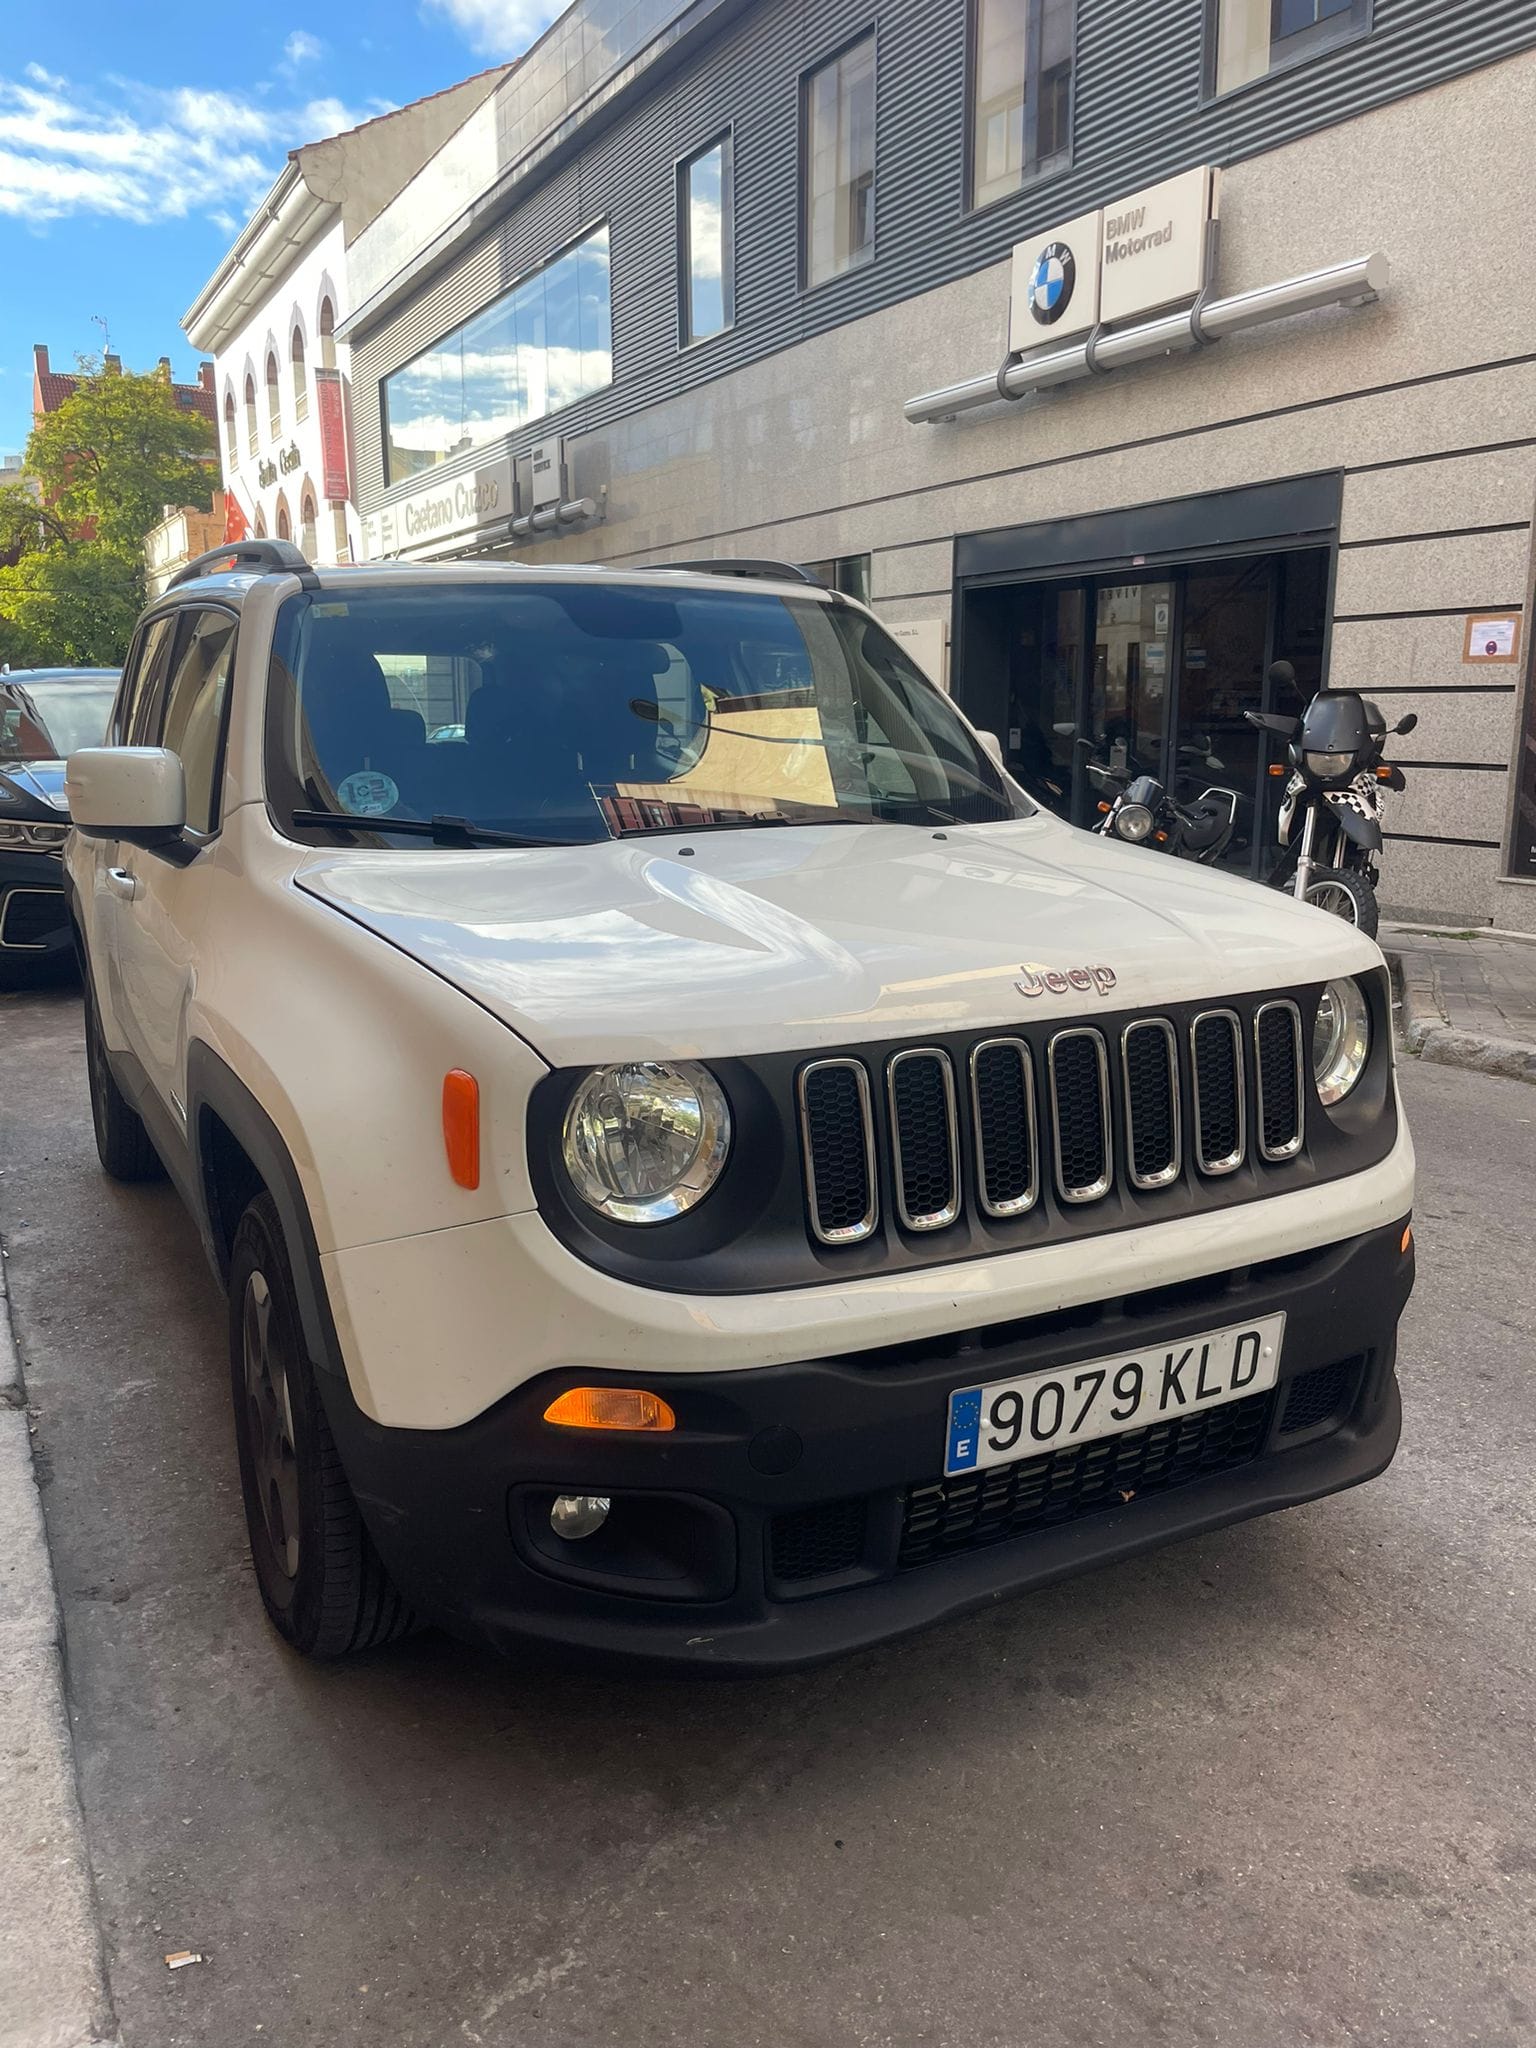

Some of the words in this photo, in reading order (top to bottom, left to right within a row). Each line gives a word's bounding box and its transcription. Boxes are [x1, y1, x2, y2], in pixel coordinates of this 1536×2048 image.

[1105, 206, 1147, 240] BMW
[1105, 220, 1173, 265] Motorrad
[405, 497, 453, 537] Caetano
[1014, 963, 1117, 998] Jeep
[987, 1362, 1144, 1452] 9079
[1158, 1330, 1262, 1411] KLD
[956, 1438, 970, 1458] E
